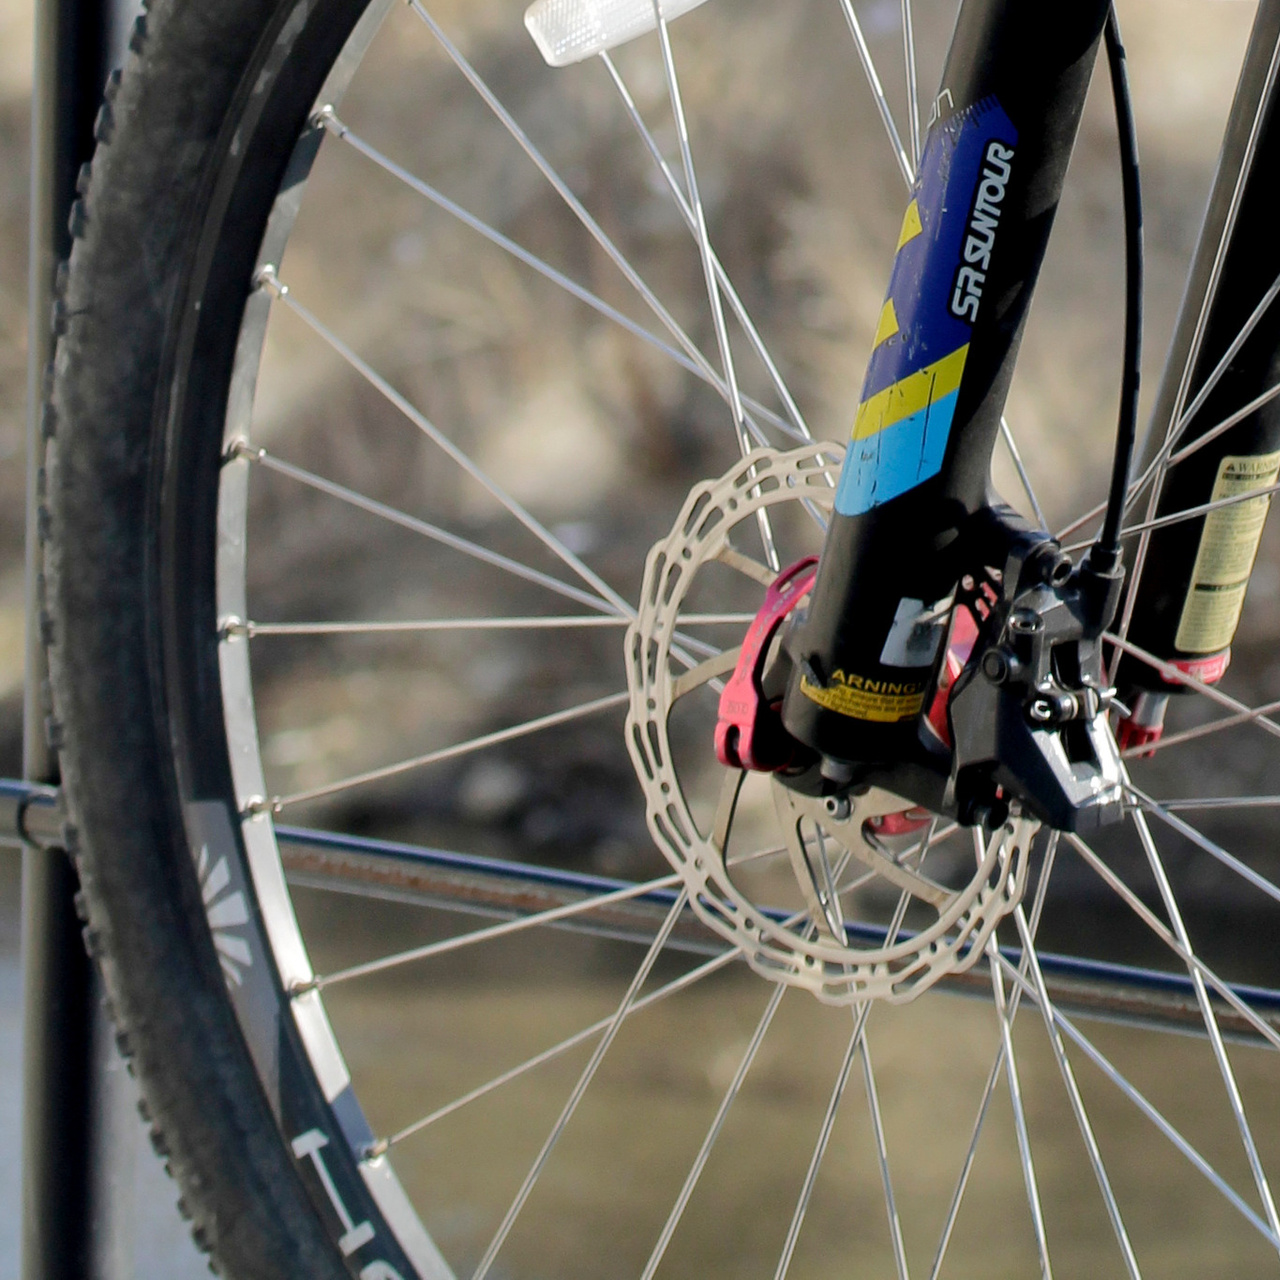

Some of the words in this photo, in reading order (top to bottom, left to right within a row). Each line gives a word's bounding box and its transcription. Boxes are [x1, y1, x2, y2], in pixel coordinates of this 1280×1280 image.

[964, 141, 1015, 271] SUNTOUR
[951, 265, 986, 323] SR
[831, 668, 921, 694] ARNING!
